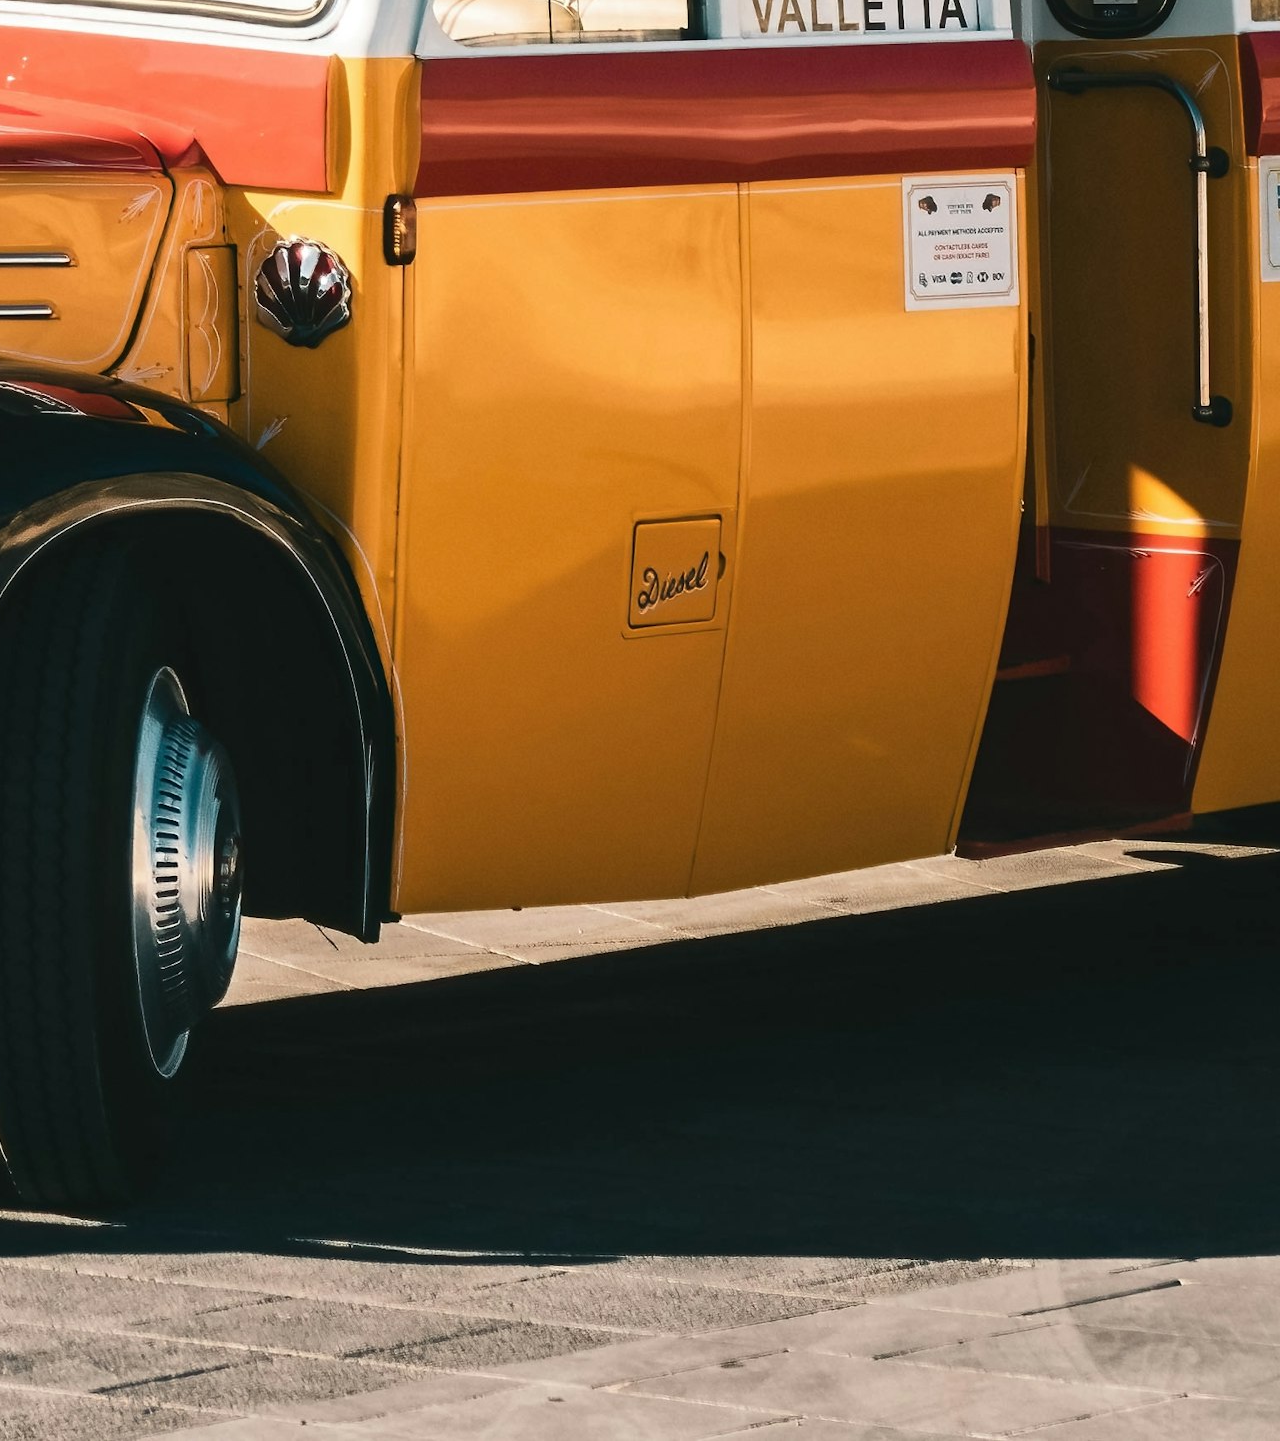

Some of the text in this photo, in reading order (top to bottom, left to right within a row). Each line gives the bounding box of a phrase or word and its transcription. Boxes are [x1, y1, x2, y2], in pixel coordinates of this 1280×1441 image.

[928, 229, 952, 237] PAYMENT
[952, 228, 977, 236] METHODS
[977, 227, 1004, 235] ACCEPTED
[932, 272, 1005, 283] VISA BOV
[638, 551, 708, 611] Diesel
